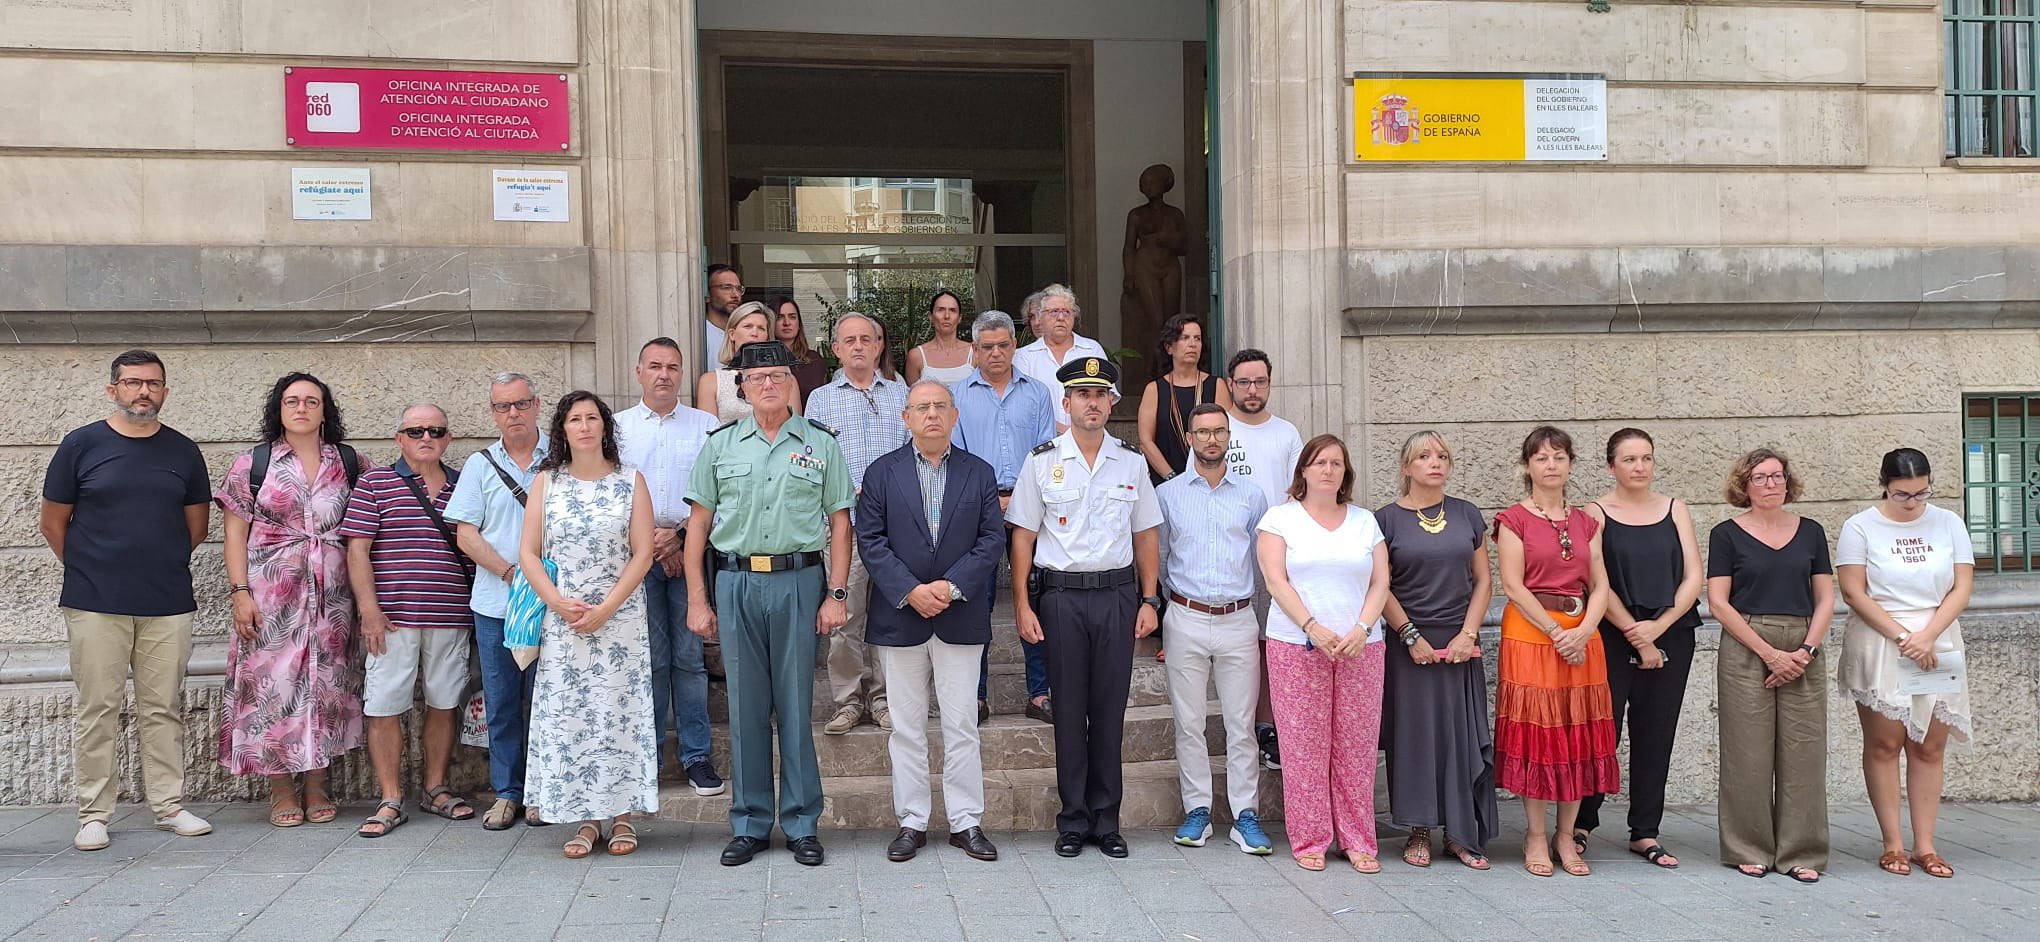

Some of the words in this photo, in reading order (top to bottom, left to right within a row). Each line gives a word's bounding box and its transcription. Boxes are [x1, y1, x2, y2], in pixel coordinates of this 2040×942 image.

[388, 79, 442, 91] OFICINA
[446, 82, 520, 93] INTEGRADA
[523, 84, 541, 94] DE
[307, 93, 330, 103] red
[380, 93, 447, 105] ATENCIÓN
[451, 96, 468, 105] AL
[470, 96, 549, 108] CIUDADANO
[307, 103, 332, 116] 060
[1547, 104, 1567, 112] ILLES
[1568, 104, 1599, 112] BALEARS
[399, 112, 453, 124] OFICINA
[457, 115, 531, 126] INTEGRADA
[1423, 113, 1481, 123] GOBIERNO
[391, 126, 461, 138] D'ATENCIÓ
[465, 129, 481, 138] AL
[484, 127, 540, 139] CIUTADÀ
[1423, 127, 1438, 137] DE
[1441, 125, 1482, 137] ESPAÑA
[299, 185, 342, 194] refúgiate
[955, 216, 972, 225] DEL
[893, 225, 943, 234] GOBIERNO
[944, 225, 958, 234] EN
[1895, 537, 1924, 547] ROME
[1890, 546, 1902, 554] LA
[1902, 554, 1926, 563] 1960
